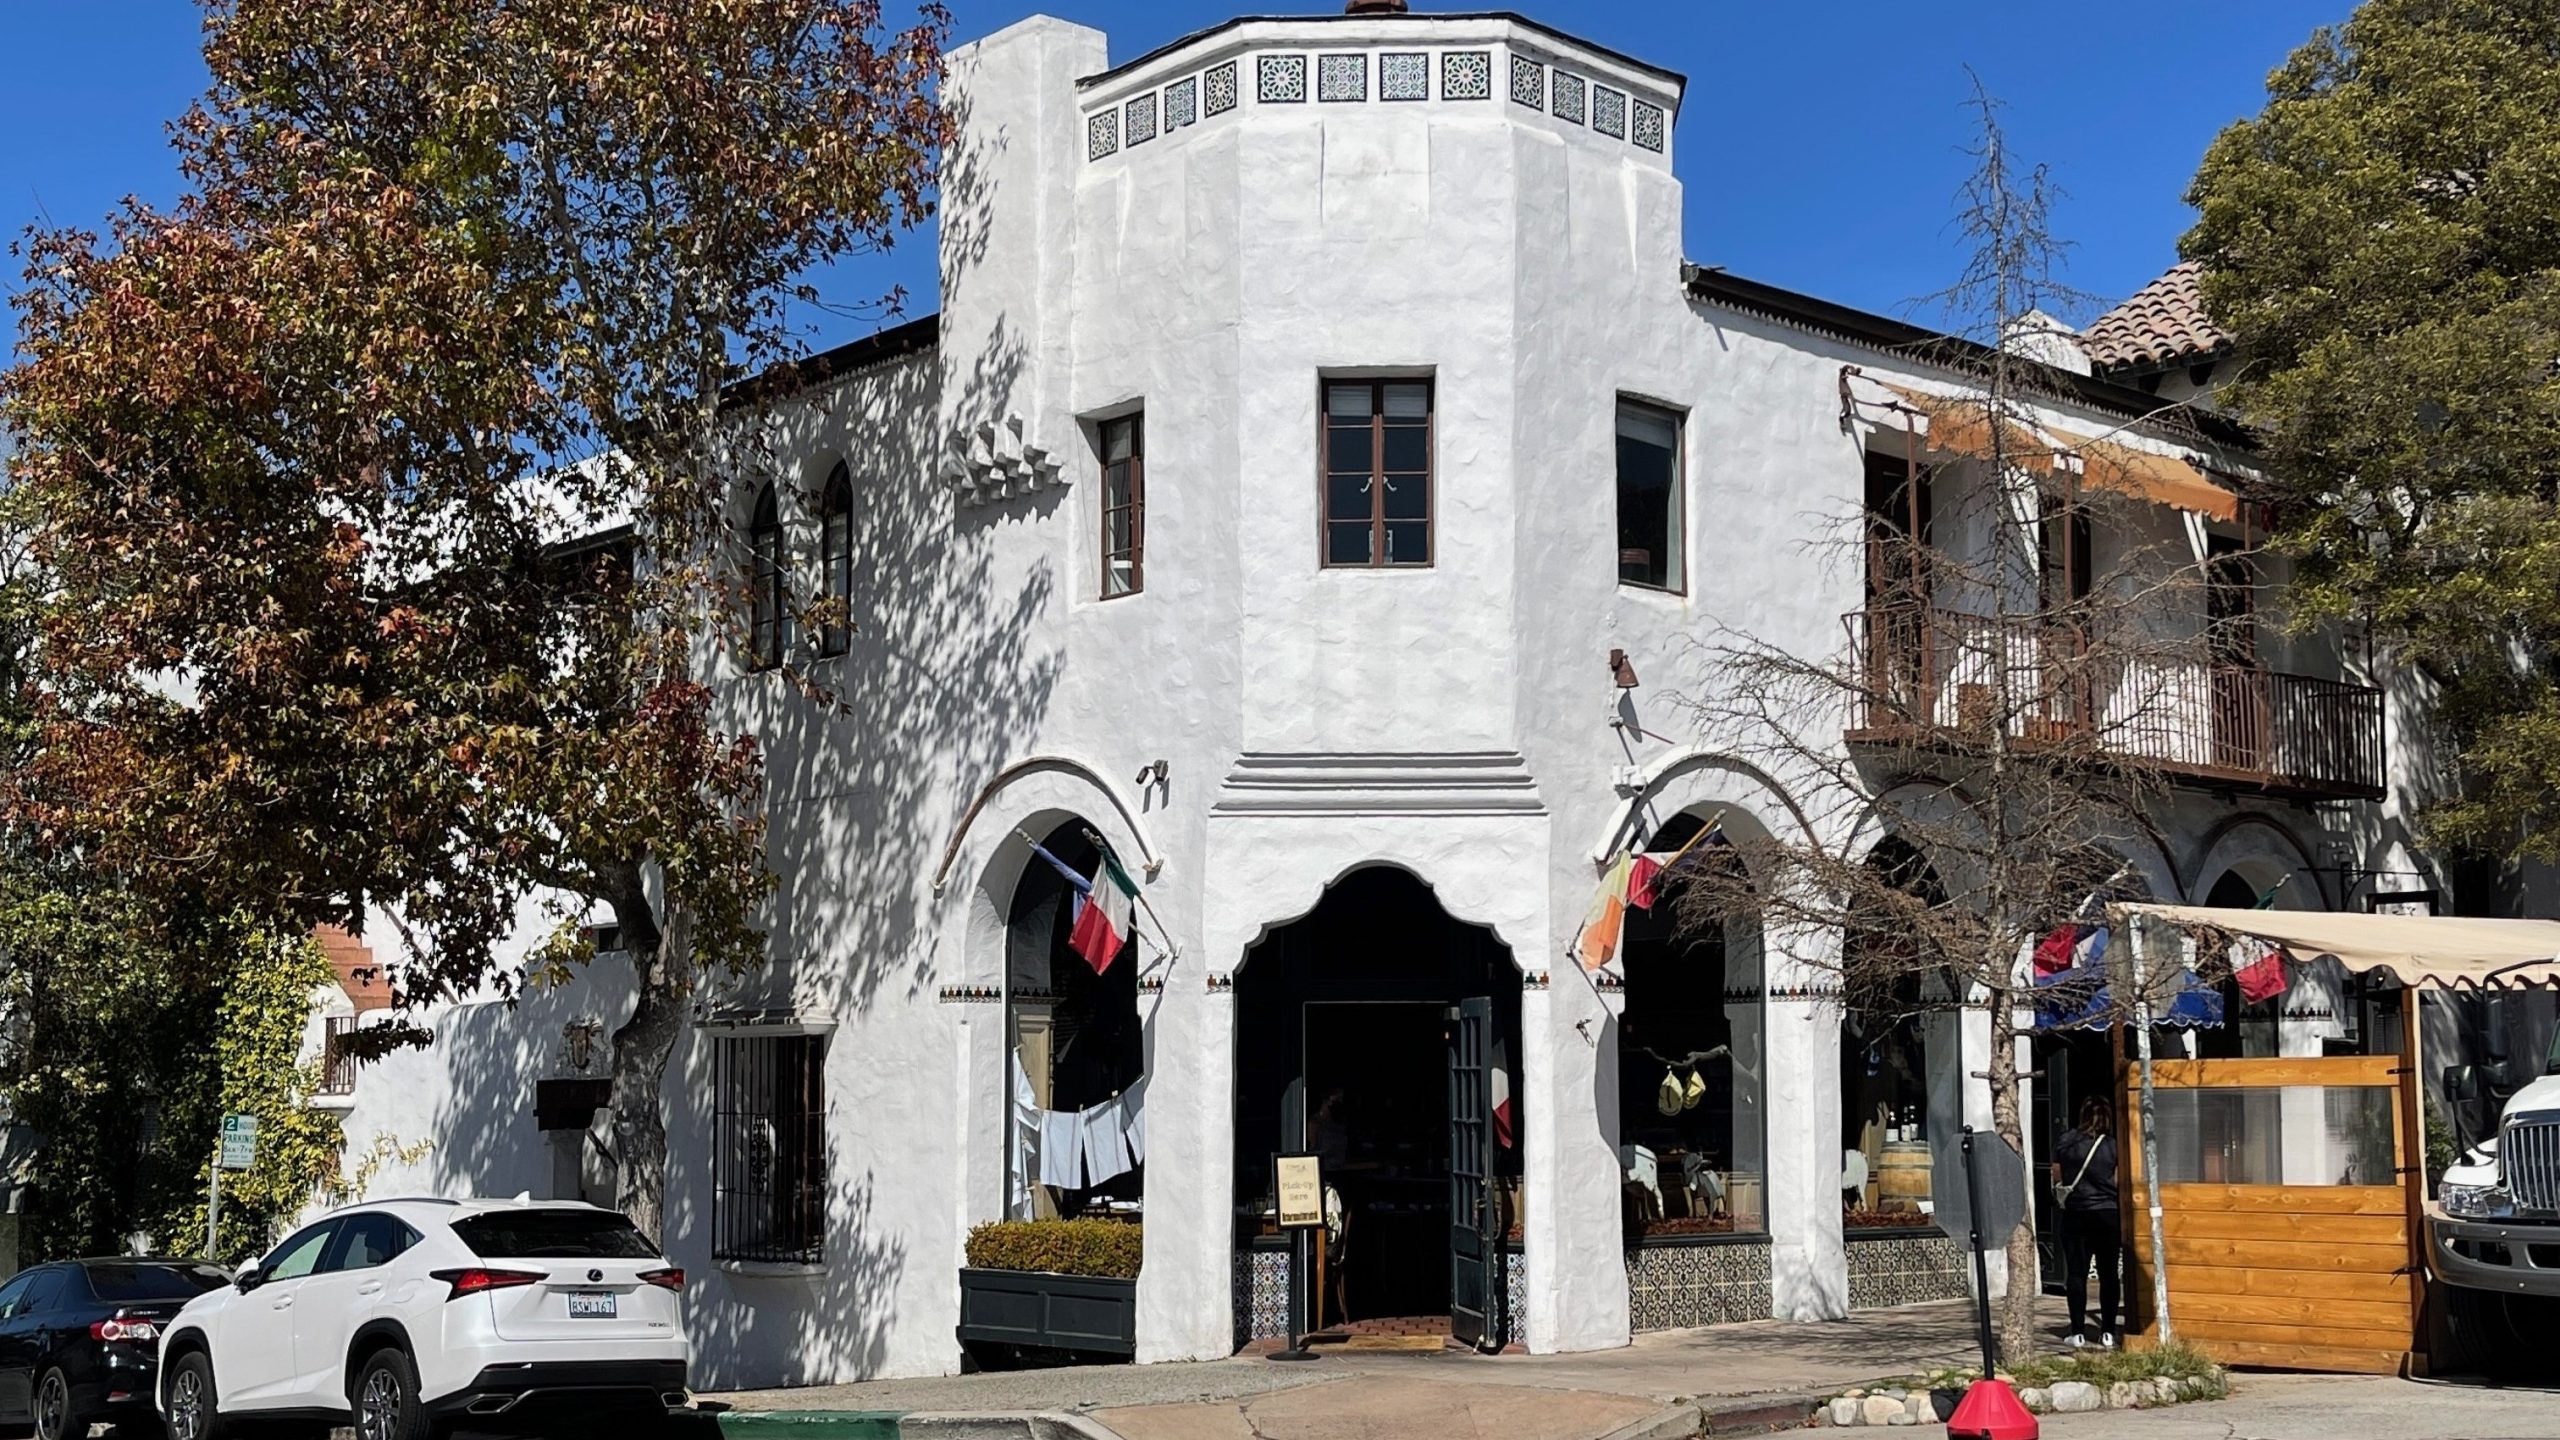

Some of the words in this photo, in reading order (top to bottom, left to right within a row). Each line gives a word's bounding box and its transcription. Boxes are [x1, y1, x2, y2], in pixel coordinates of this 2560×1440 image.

[226, 1118, 235, 1129] 2
[224, 1134, 254, 1143] PARKING
[1282, 1182, 1314, 1190] Pick-Up
